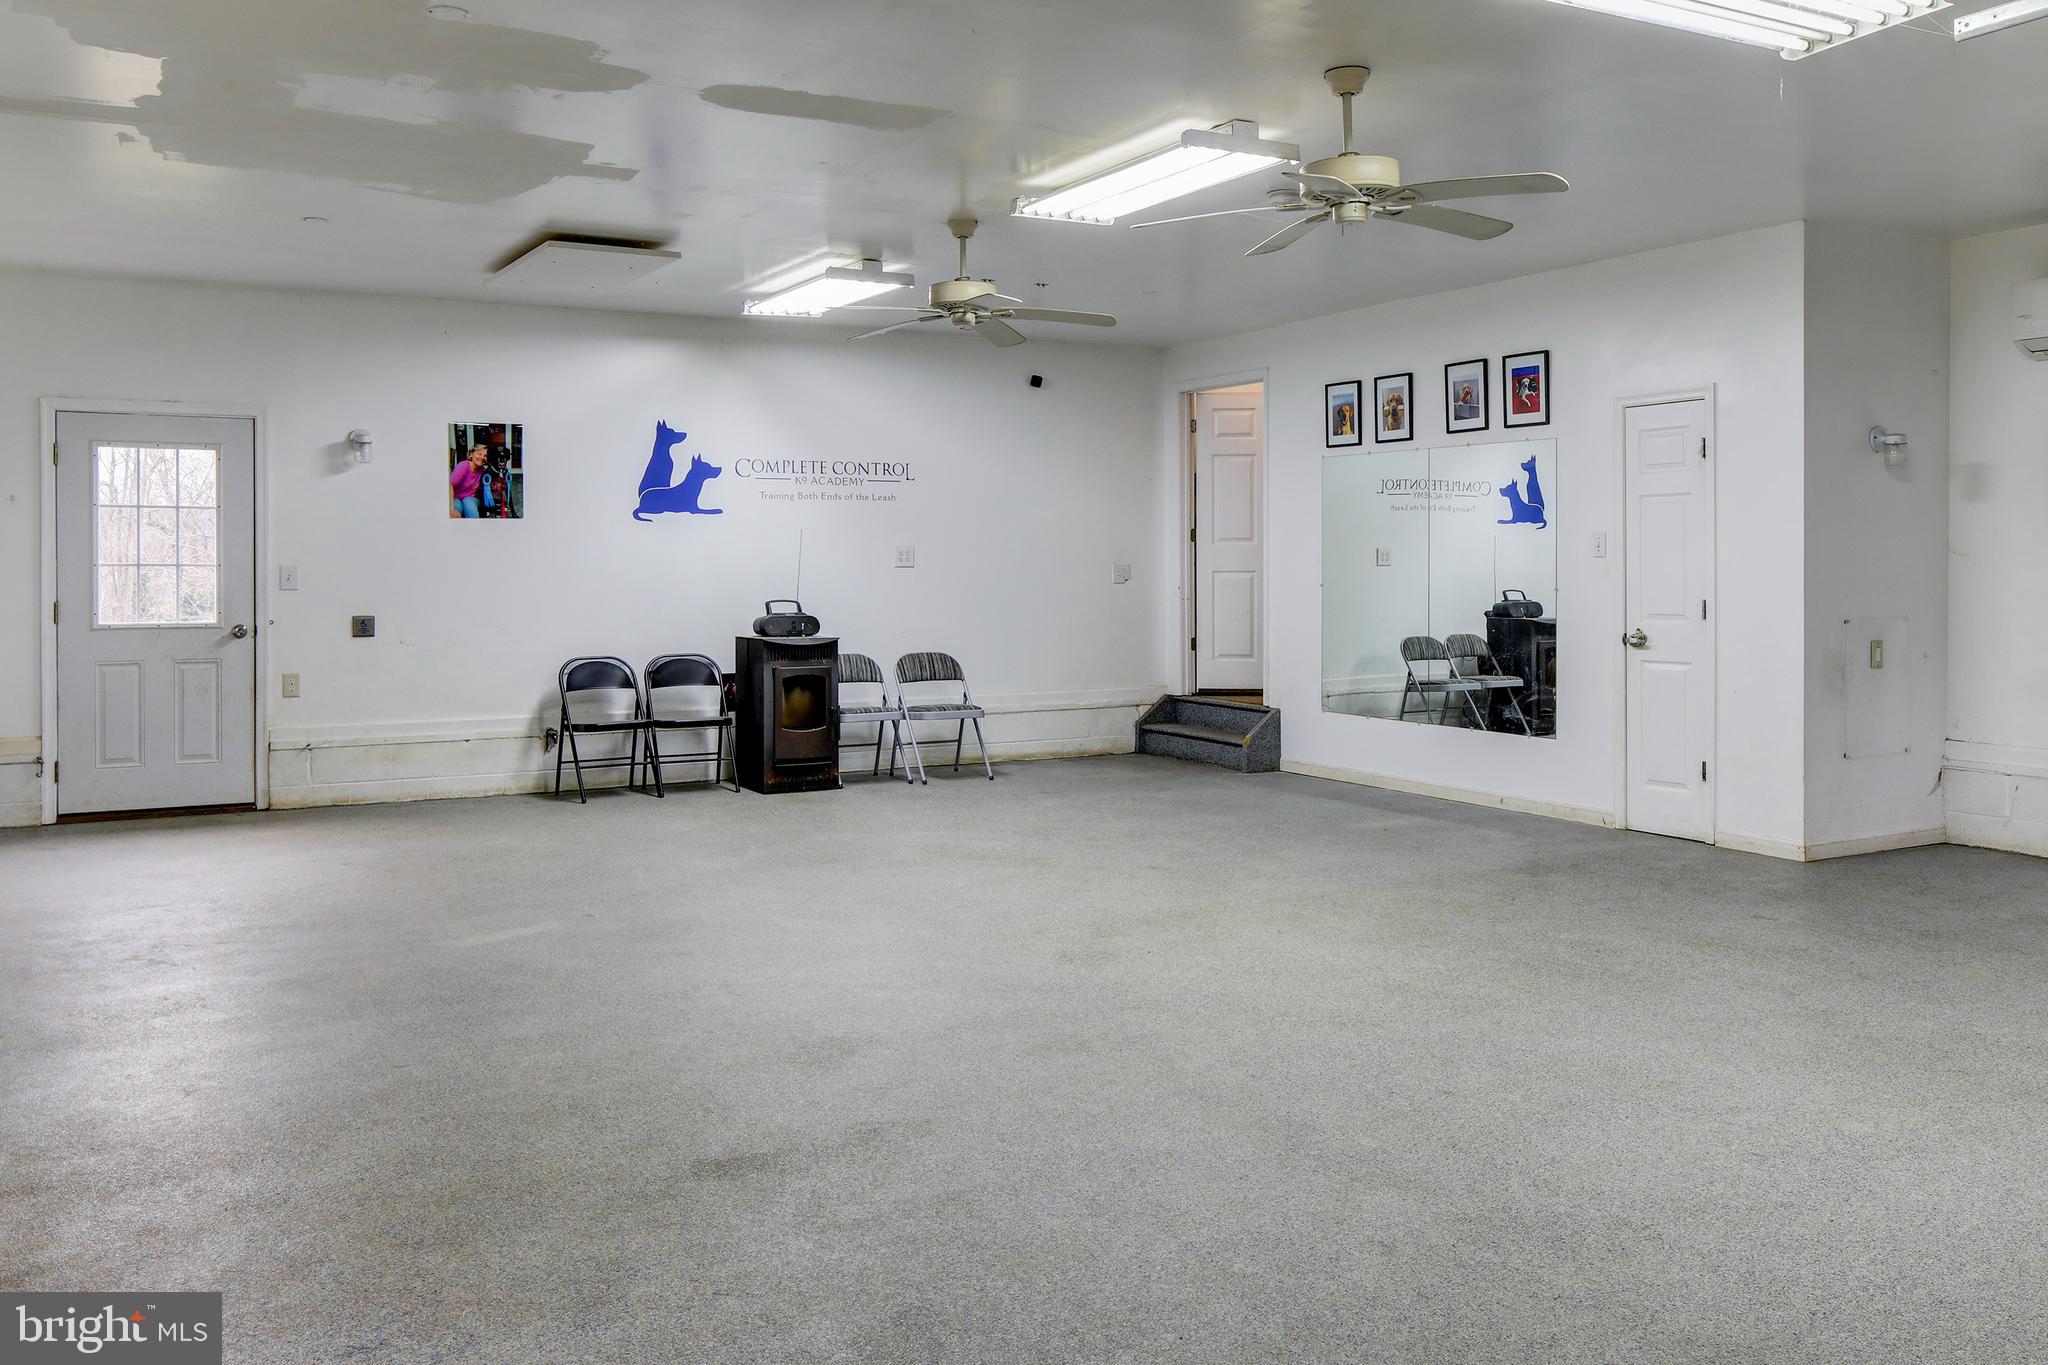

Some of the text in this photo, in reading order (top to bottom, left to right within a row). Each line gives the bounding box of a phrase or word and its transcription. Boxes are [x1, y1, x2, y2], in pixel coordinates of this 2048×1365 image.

[735, 458, 915, 481] COMPLETE CONTROL
[795, 477, 865, 486] K9 ACADEMY
[760, 491, 896, 502] Training Both Ends of the Leash
